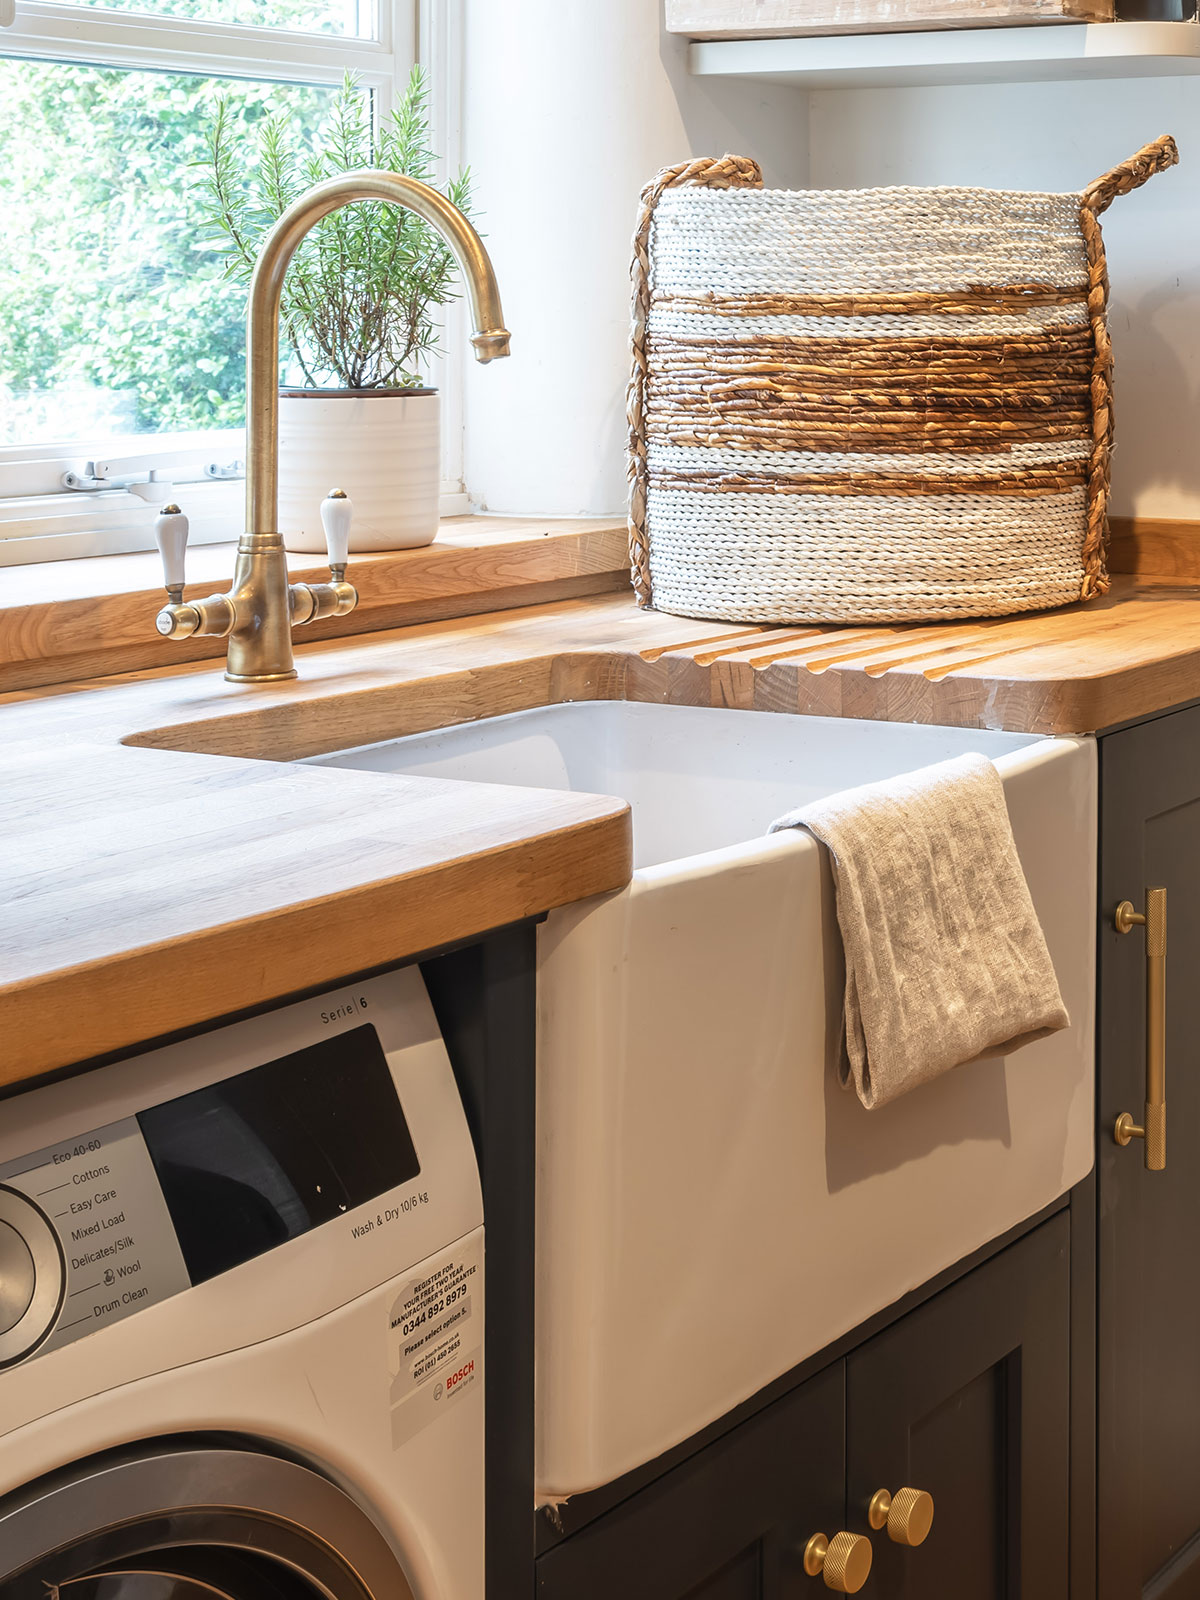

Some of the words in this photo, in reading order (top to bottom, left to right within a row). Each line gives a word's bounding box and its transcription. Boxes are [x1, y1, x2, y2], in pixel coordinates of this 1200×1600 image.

[321, 1005, 353, 1024] Serie
[52, 1152, 71, 1165] Eco
[73, 1139, 101, 1157] 40-60
[72, 1165, 110, 1185] Cottons
[70, 1199, 92, 1214] Easy
[94, 1190, 117, 1204] Care
[351, 1220, 374, 1239] Wash
[376, 1215, 383, 1226] &
[384, 1207, 399, 1222] Dry
[400, 1196, 418, 1213] 10/6
[418, 1192, 429, 1203] kg
[71, 1221, 100, 1241] Mixed
[101, 1211, 125, 1229] Load
[71, 1236, 135, 1270] Delicates/Silk
[116, 1259, 141, 1278] Wool
[414, 1271, 442, 1294] REGISTER
[442, 1263, 454, 1276] FOR
[93, 1299, 120, 1317] Drum
[121, 1287, 149, 1304] Clean
[391, 1288, 443, 1328] MANUFACTURER'S
[444, 1265, 476, 1293] GUARANTEE
[404, 1295, 419, 1310] YOUR
[420, 1284, 435, 1299] FREE
[435, 1276, 449, 1289] TWO
[449, 1265, 464, 1280] YEAR
[403, 1312, 426, 1336] 0344
[428, 1300, 444, 1319] 892
[446, 1284, 467, 1306] 8979
[404, 1339, 424, 1356] Please
[425, 1325, 442, 1342] select
[446, 1360, 474, 1390] BOSCH
